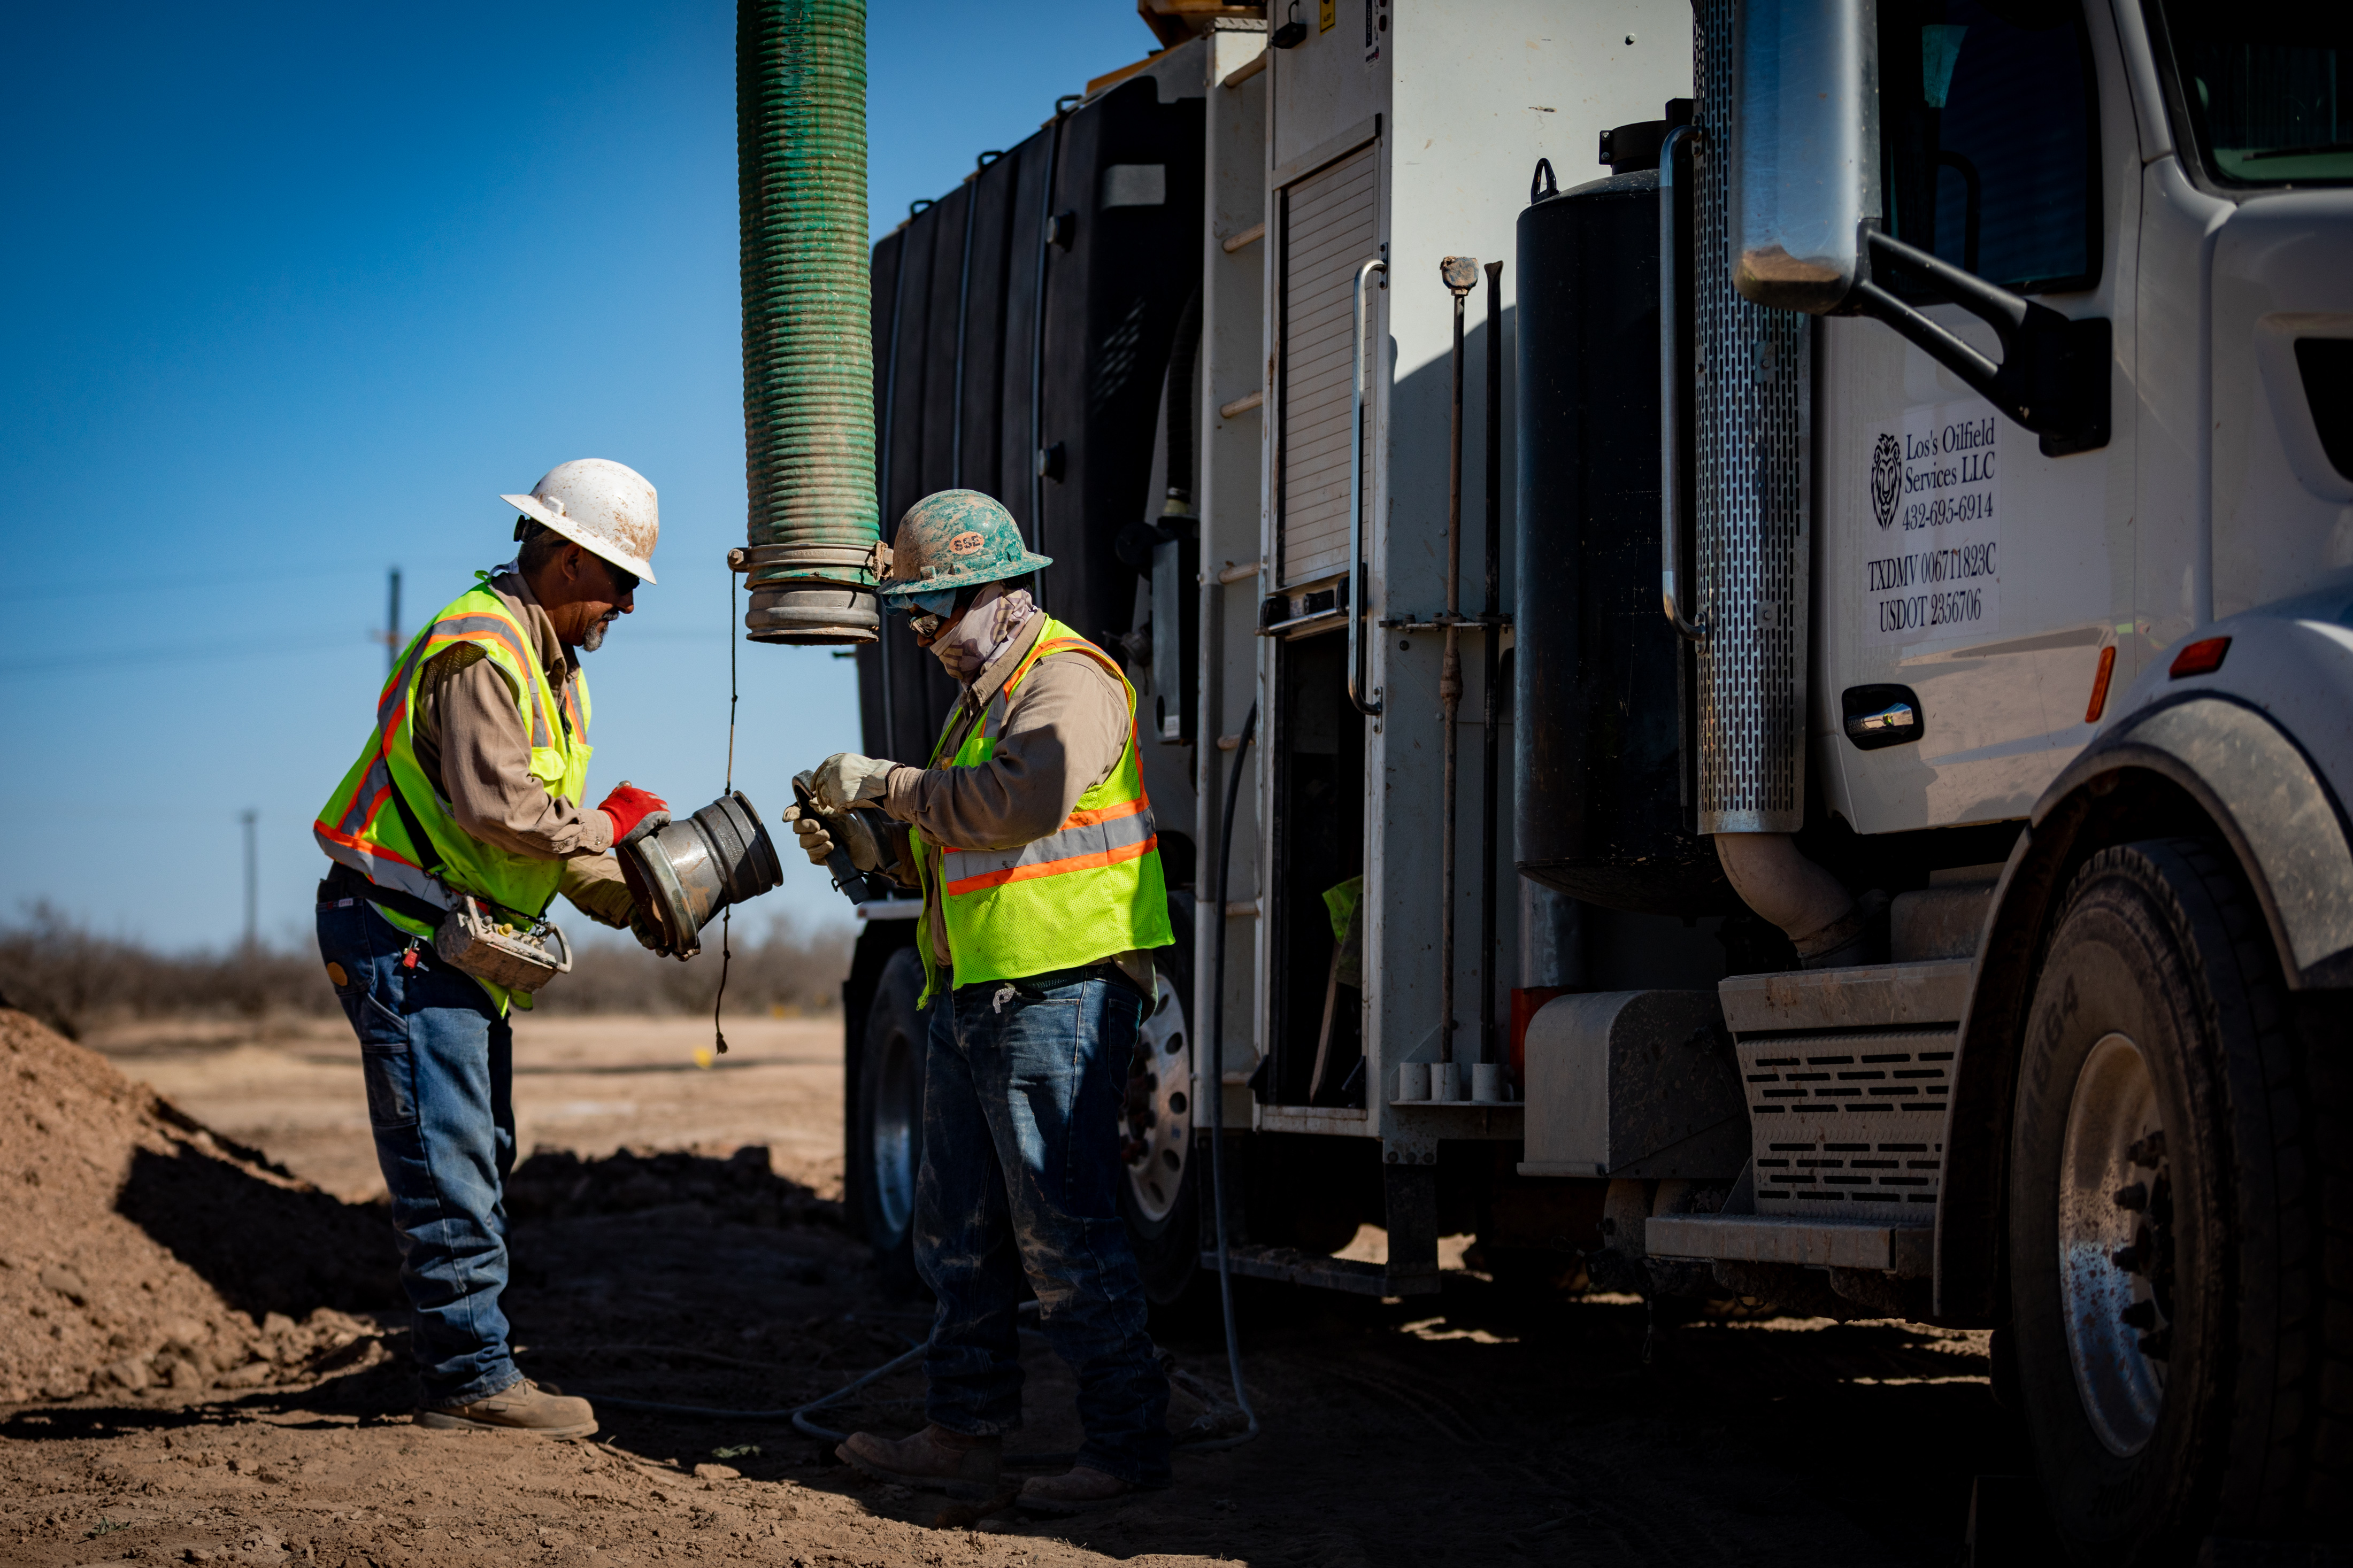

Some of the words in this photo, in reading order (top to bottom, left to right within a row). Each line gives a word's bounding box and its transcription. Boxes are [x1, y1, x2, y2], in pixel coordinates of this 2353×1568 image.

[1906, 430, 1938, 461] Los's
[1942, 418, 1995, 453] Oilfield
[1905, 462, 1957, 493] Services
[1961, 451, 1995, 484] LLC
[1902, 492, 1993, 531] 432-695-6914
[1867, 554, 1919, 592] TXDMV
[1921, 542, 1996, 584] 006711823C
[1879, 596, 1927, 632] USDOT
[1931, 589, 1981, 625] 2356706
